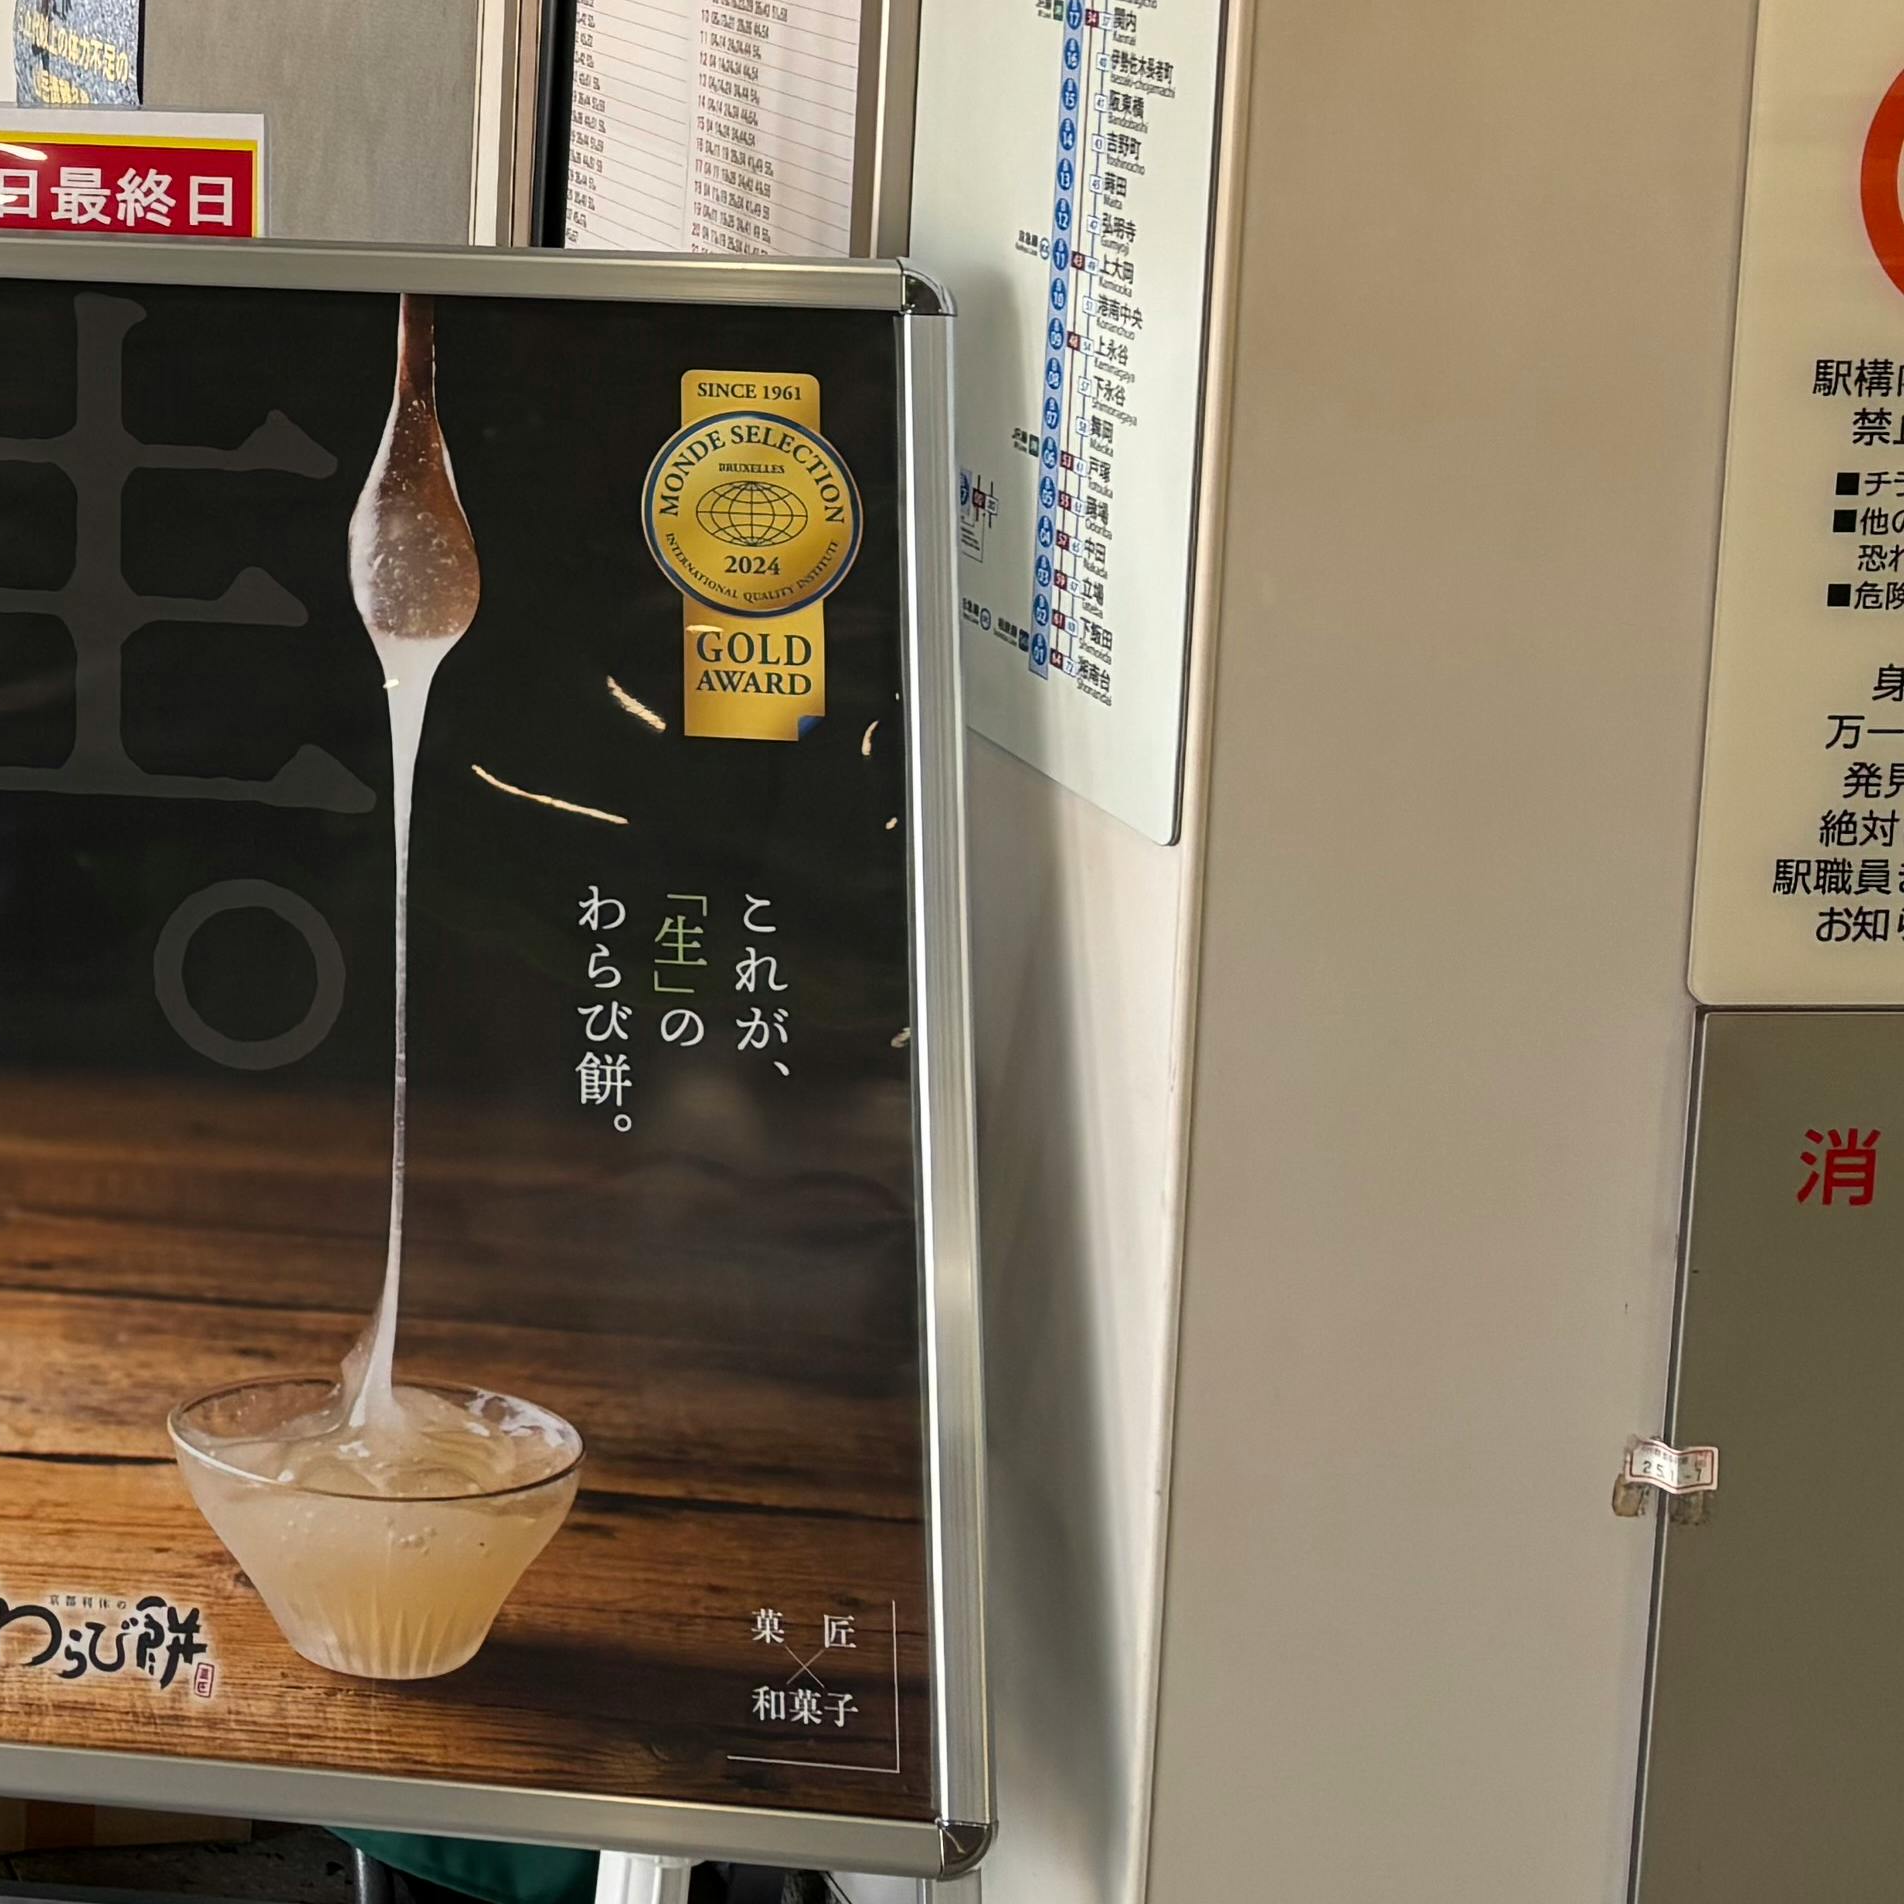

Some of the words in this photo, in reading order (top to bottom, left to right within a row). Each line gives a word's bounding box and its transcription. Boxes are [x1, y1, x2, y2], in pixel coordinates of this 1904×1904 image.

[698, 382, 757, 399] SINCE
[762, 385, 802, 401] 1961
[1814, 358, 1904, 398] 駅構
[659, 430, 726, 517] MONDE
[731, 425, 845, 524] SELECTION
[719, 462, 785, 474] BRUXELLES
[724, 556, 780, 576] 2024
[696, 632, 812, 667] GOLD
[696, 670, 811, 696] AWARD
[654, 893, 707, 1047] 「生」の
[736, 893, 790, 1076] これが、
[575, 885, 633, 1132] わらび餅。
[1797, 1127, 1881, 1208] 消
[751, 1685, 859, 1728] 和菓子
